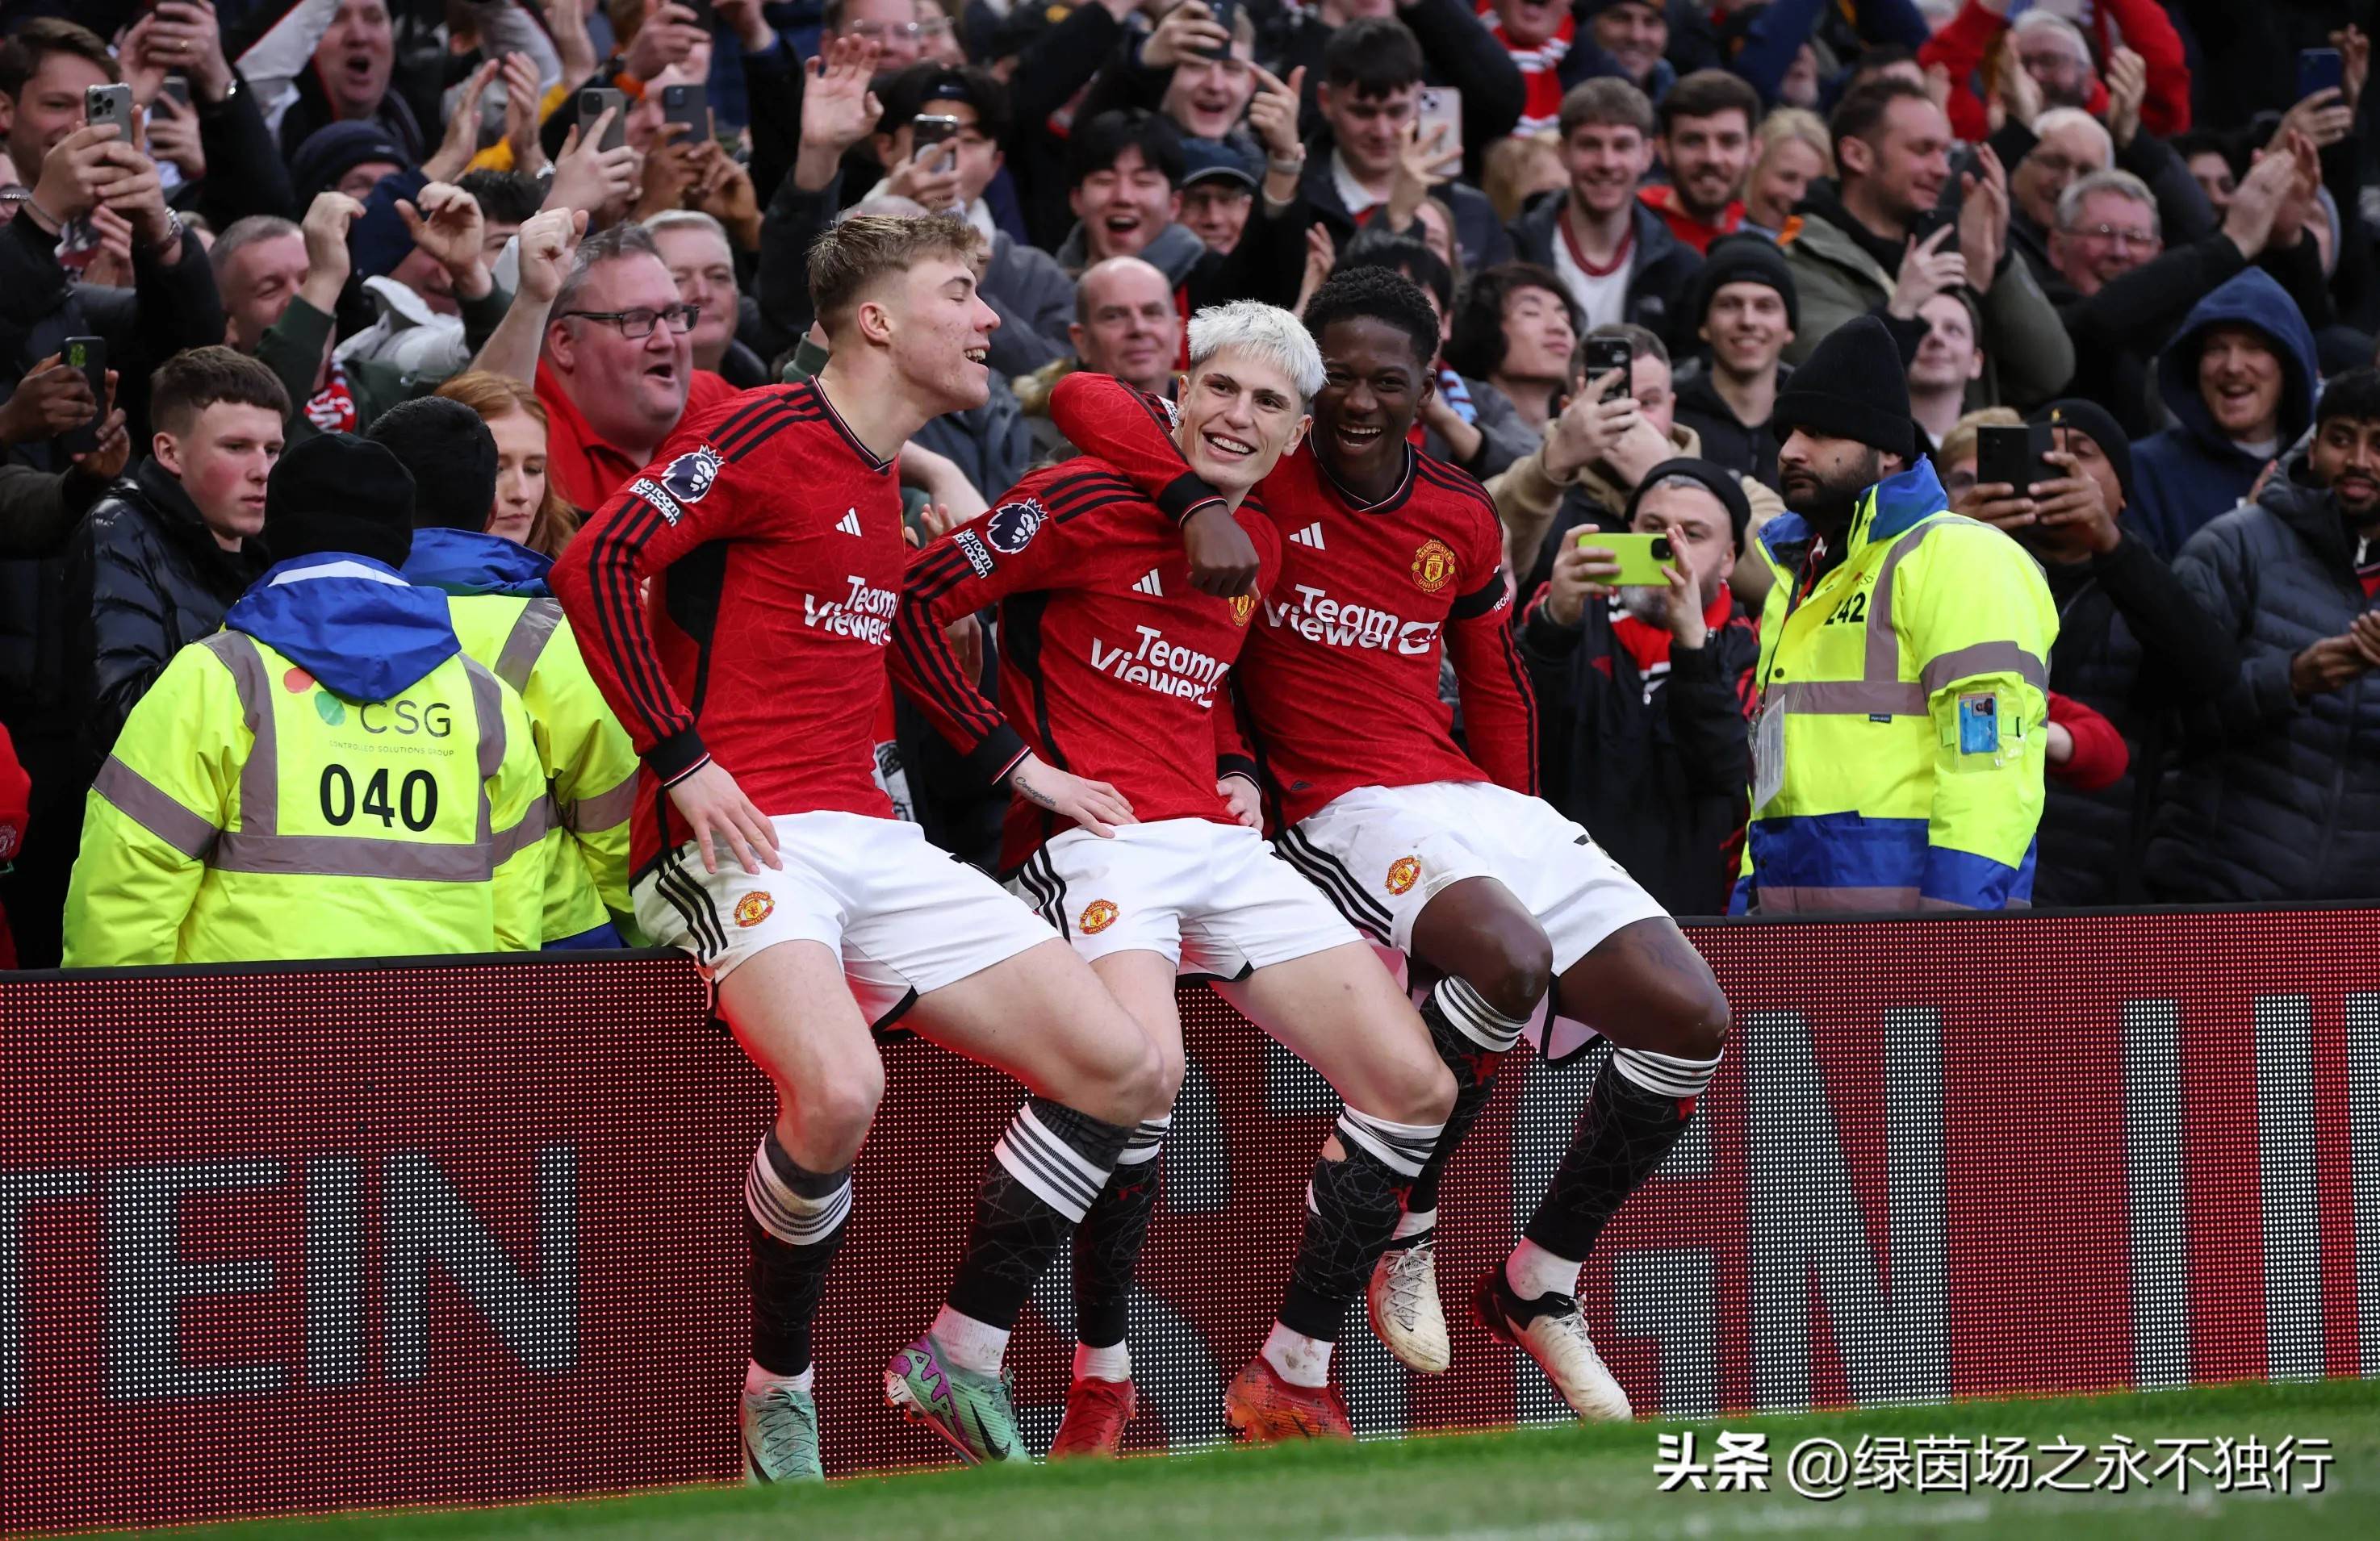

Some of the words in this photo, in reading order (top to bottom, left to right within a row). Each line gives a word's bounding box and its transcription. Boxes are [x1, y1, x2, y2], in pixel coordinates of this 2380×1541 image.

[646, 494, 677, 527] racism
[651, 487, 681, 516] room
[961, 543, 988, 579] racism
[970, 539, 993, 570] room
[1419, 543, 1454, 562] MANCHESTER
[843, 574, 896, 619] Team
[1418, 578, 1444, 590] UNITED
[804, 593, 889, 645] Viewer
[1295, 583, 1399, 633] Team
[1090, 637, 1205, 702] Viewer
[1135, 624, 1216, 683] Team
[360, 700, 451, 737] CSG
[320, 763, 438, 832] 040
